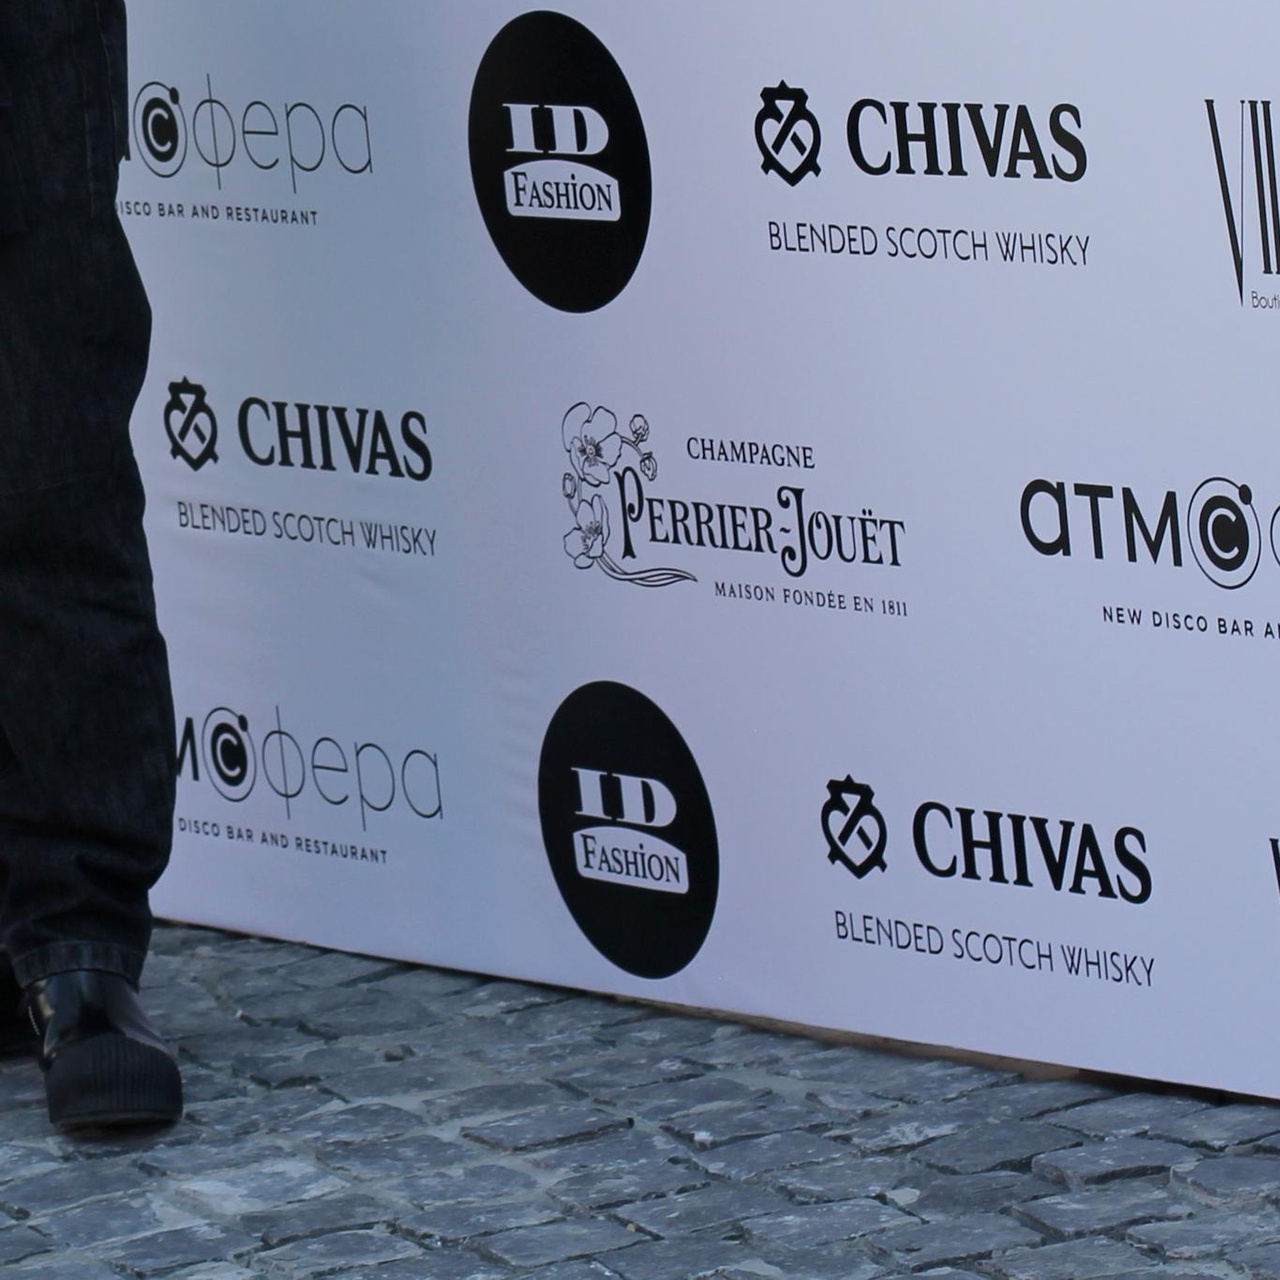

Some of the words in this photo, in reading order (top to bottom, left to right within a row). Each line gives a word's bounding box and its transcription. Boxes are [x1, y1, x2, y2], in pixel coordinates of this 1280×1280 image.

[503, 103, 610, 155] ID
[847, 99, 1087, 182] CHIVAS
[158, 203, 184, 217] BAR
[192, 205, 219, 219] AND
[226, 206, 317, 225] RESTAURANT
[769, 221, 877, 255] BLENDED
[886, 227, 988, 260] SCOTCH
[996, 232, 1089, 265] WHISKY
[238, 397, 432, 481] CHIVAS
[687, 437, 815, 469] CHAMPAGNE
[177, 501, 266, 536] BLENDED
[272, 511, 355, 546] SCOTCH
[360, 522, 436, 556] WHISKY
[715, 582, 774, 601] MAISON
[783, 588, 846, 609] FONDÉE
[854, 596, 873, 612] EN
[882, 600, 907, 616] 1811
[1103, 606, 1141, 625] NEW
[1152, 611, 1207, 632] DISCO
[1218, 618, 1253, 636] BAR
[571, 767, 677, 827] ID
[179, 818, 220, 837] DISCO
[227, 826, 253, 841] BAR
[261, 832, 288, 848] AND
[295, 837, 387, 863] RESTAURANT
[913, 802, 1152, 904] CHIVAS
[835, 911, 943, 954] BLENDED
[952, 929, 1053, 971] SCOTCH
[1061, 945, 1154, 986] WHISKY
